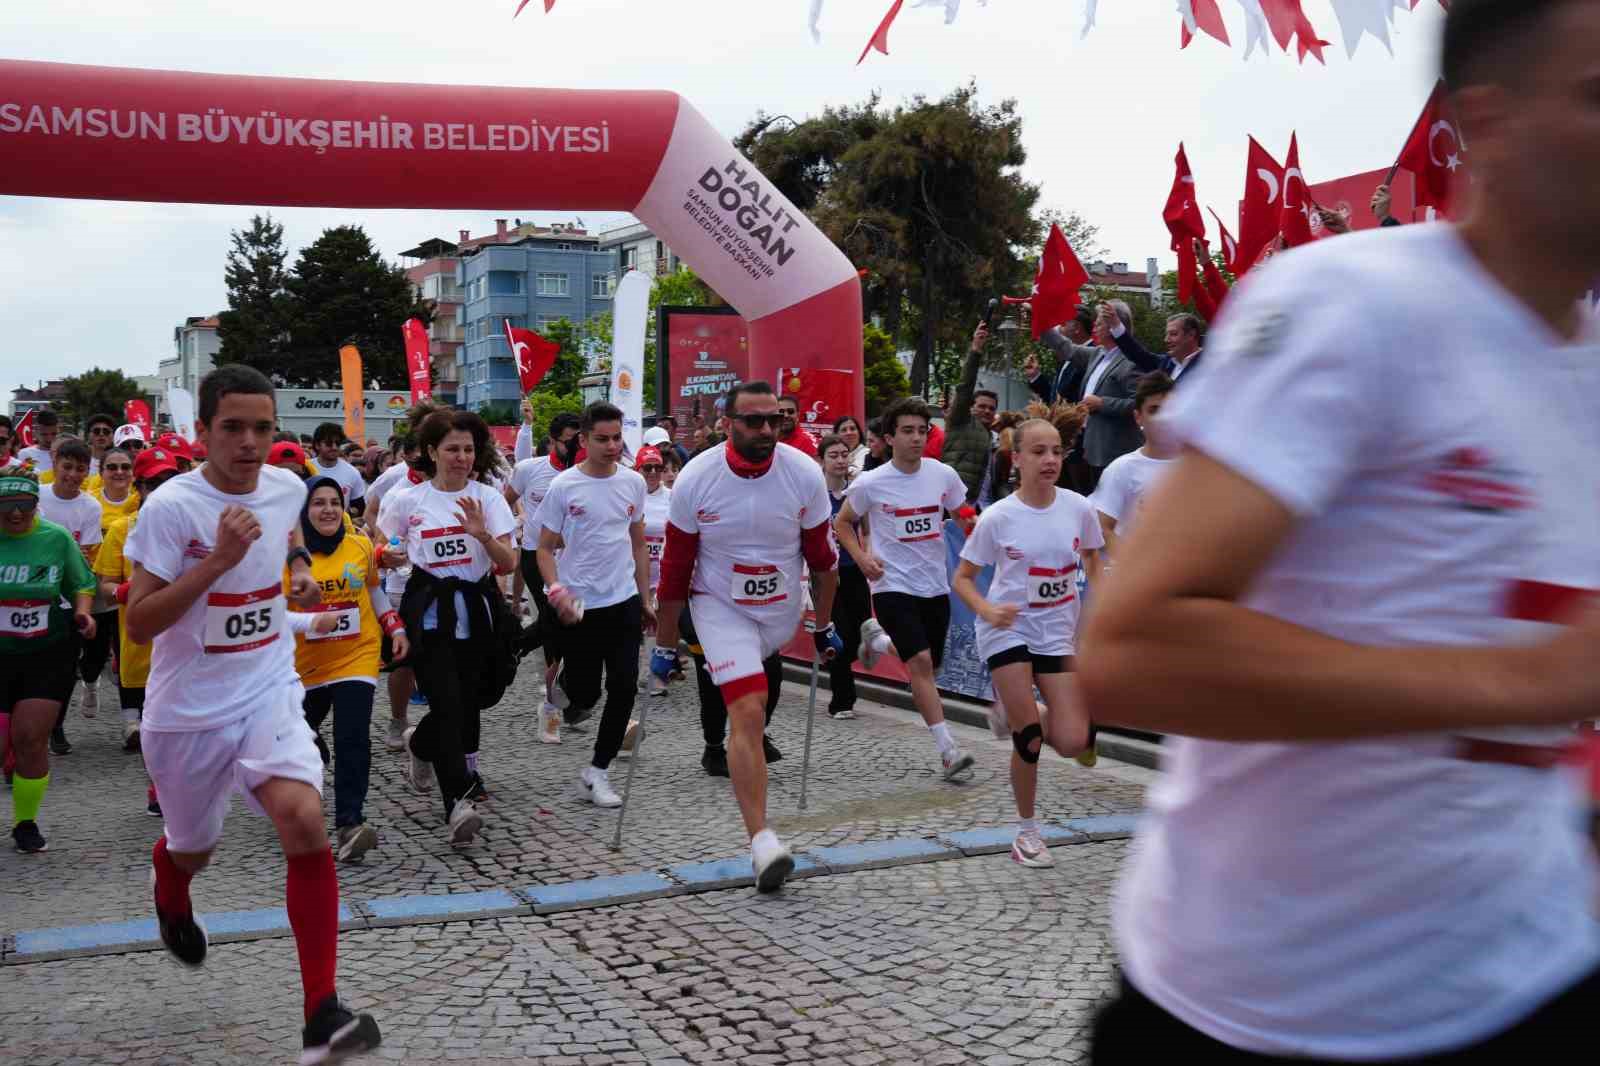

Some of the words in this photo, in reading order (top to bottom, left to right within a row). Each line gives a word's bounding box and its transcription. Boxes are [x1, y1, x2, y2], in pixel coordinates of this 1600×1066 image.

[0, 103, 166, 140] SAMSUN
[177, 108, 415, 154] BÜYÜKŞEHİR
[423, 119, 610, 153] BELEDİYESİ
[686, 188, 723, 227] SAMSUN
[698, 166, 795, 266] DOĞAN
[295, 396, 340, 409] Sanat
[904, 517, 932, 534] 055
[434, 538, 468, 558] 055
[744, 577, 778, 597] 055
[1038, 578, 1069, 599] 055
[10, 610, 40, 629] 055
[224, 607, 272, 639] 055
